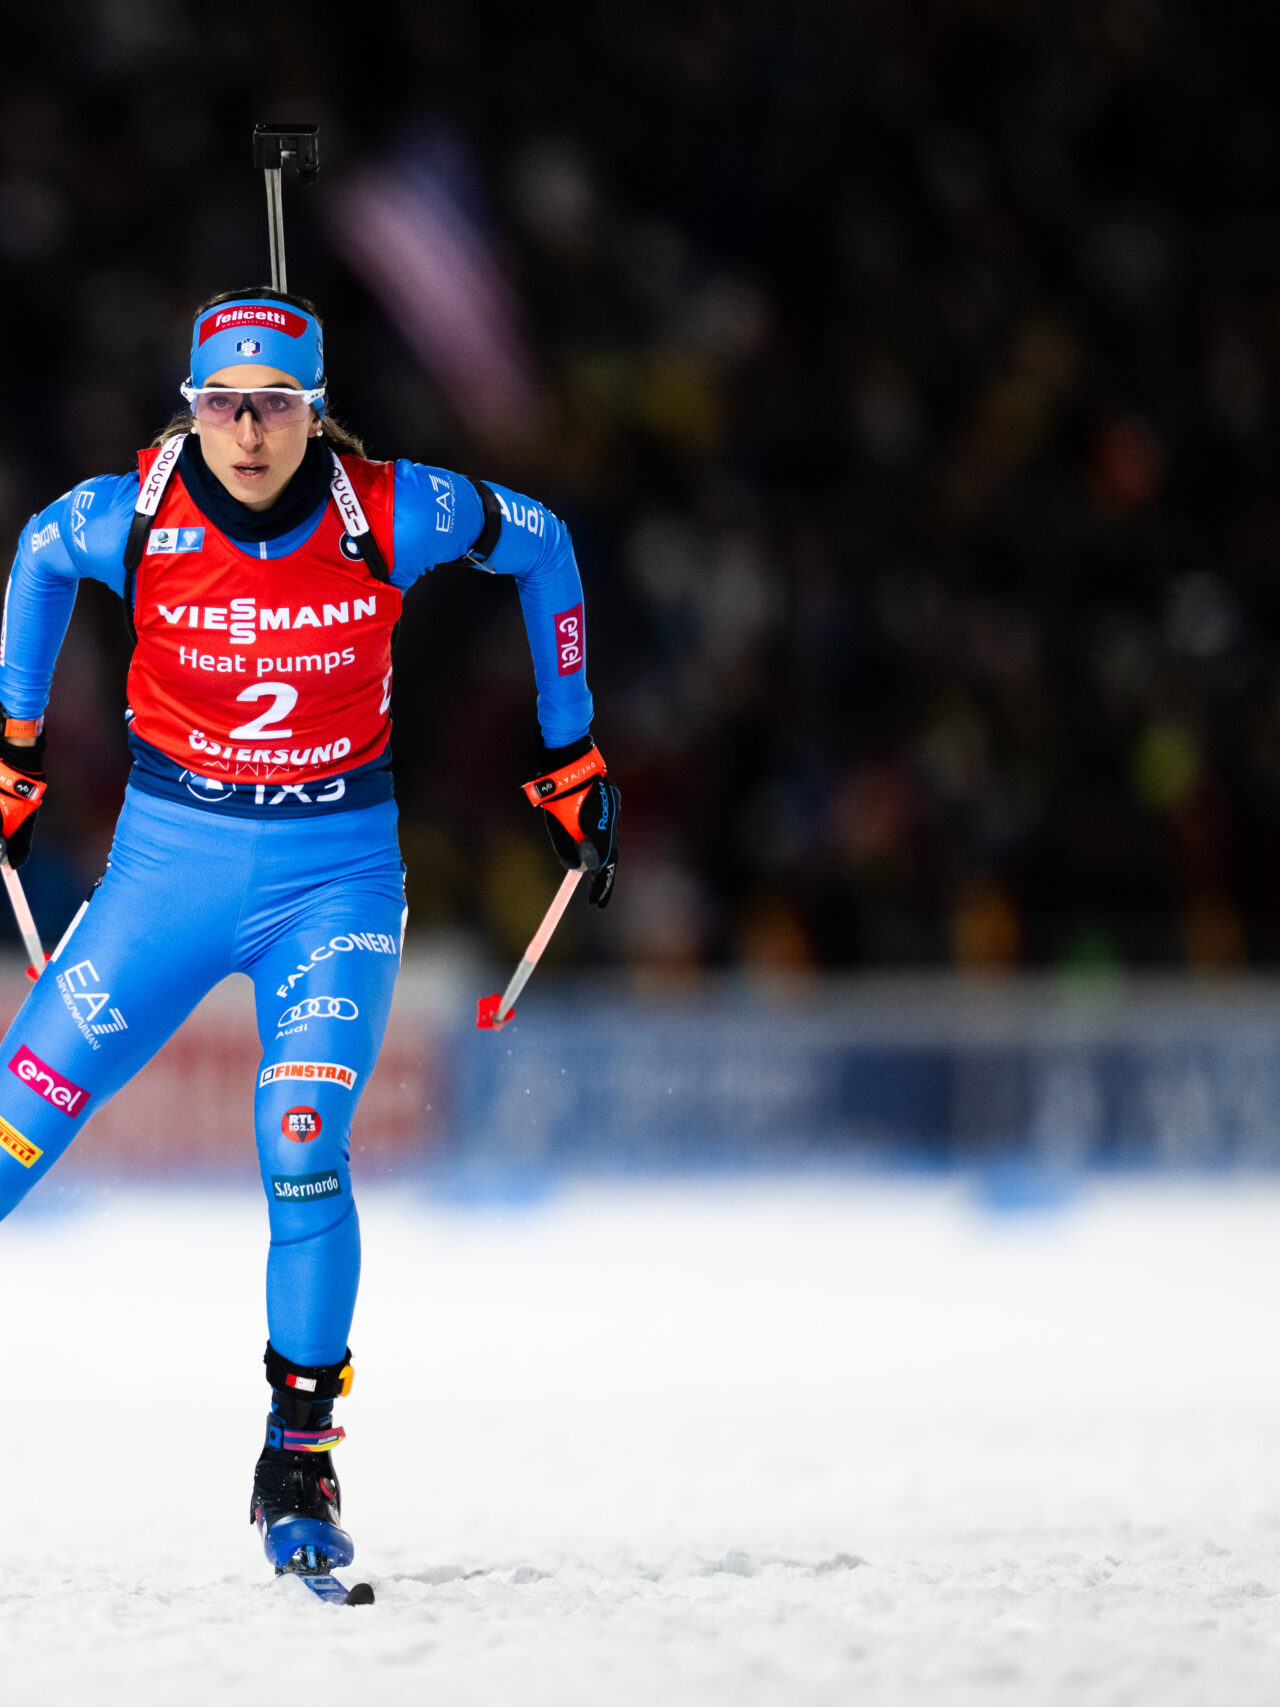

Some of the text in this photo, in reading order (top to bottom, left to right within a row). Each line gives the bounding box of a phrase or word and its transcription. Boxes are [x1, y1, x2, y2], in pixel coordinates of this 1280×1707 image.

[215, 309, 286, 328] felicetti
[73, 490, 96, 554] EA7
[331, 466, 361, 532] OCCHI
[429, 473, 452, 533] EA7
[494, 492, 545, 538] Audi
[157, 595, 377, 645] VIESSMANN
[559, 616, 582, 669] enel
[179, 645, 356, 678] Heat pumps
[228, 681, 300, 741] 2
[188, 728, 352, 766] ÖSTERSUND
[275, 932, 397, 999] FALCONERI
[64, 959, 129, 1036] EA7
[274, 1023, 309, 1041] Audi
[16, 1058, 82, 1113] enel
[274, 1064, 353, 1086] FINSTRAL
[288, 1113, 316, 1125] RTL
[288, 1124, 317, 1132] 102.5
[273, 1174, 339, 1198] S.Bernardo
